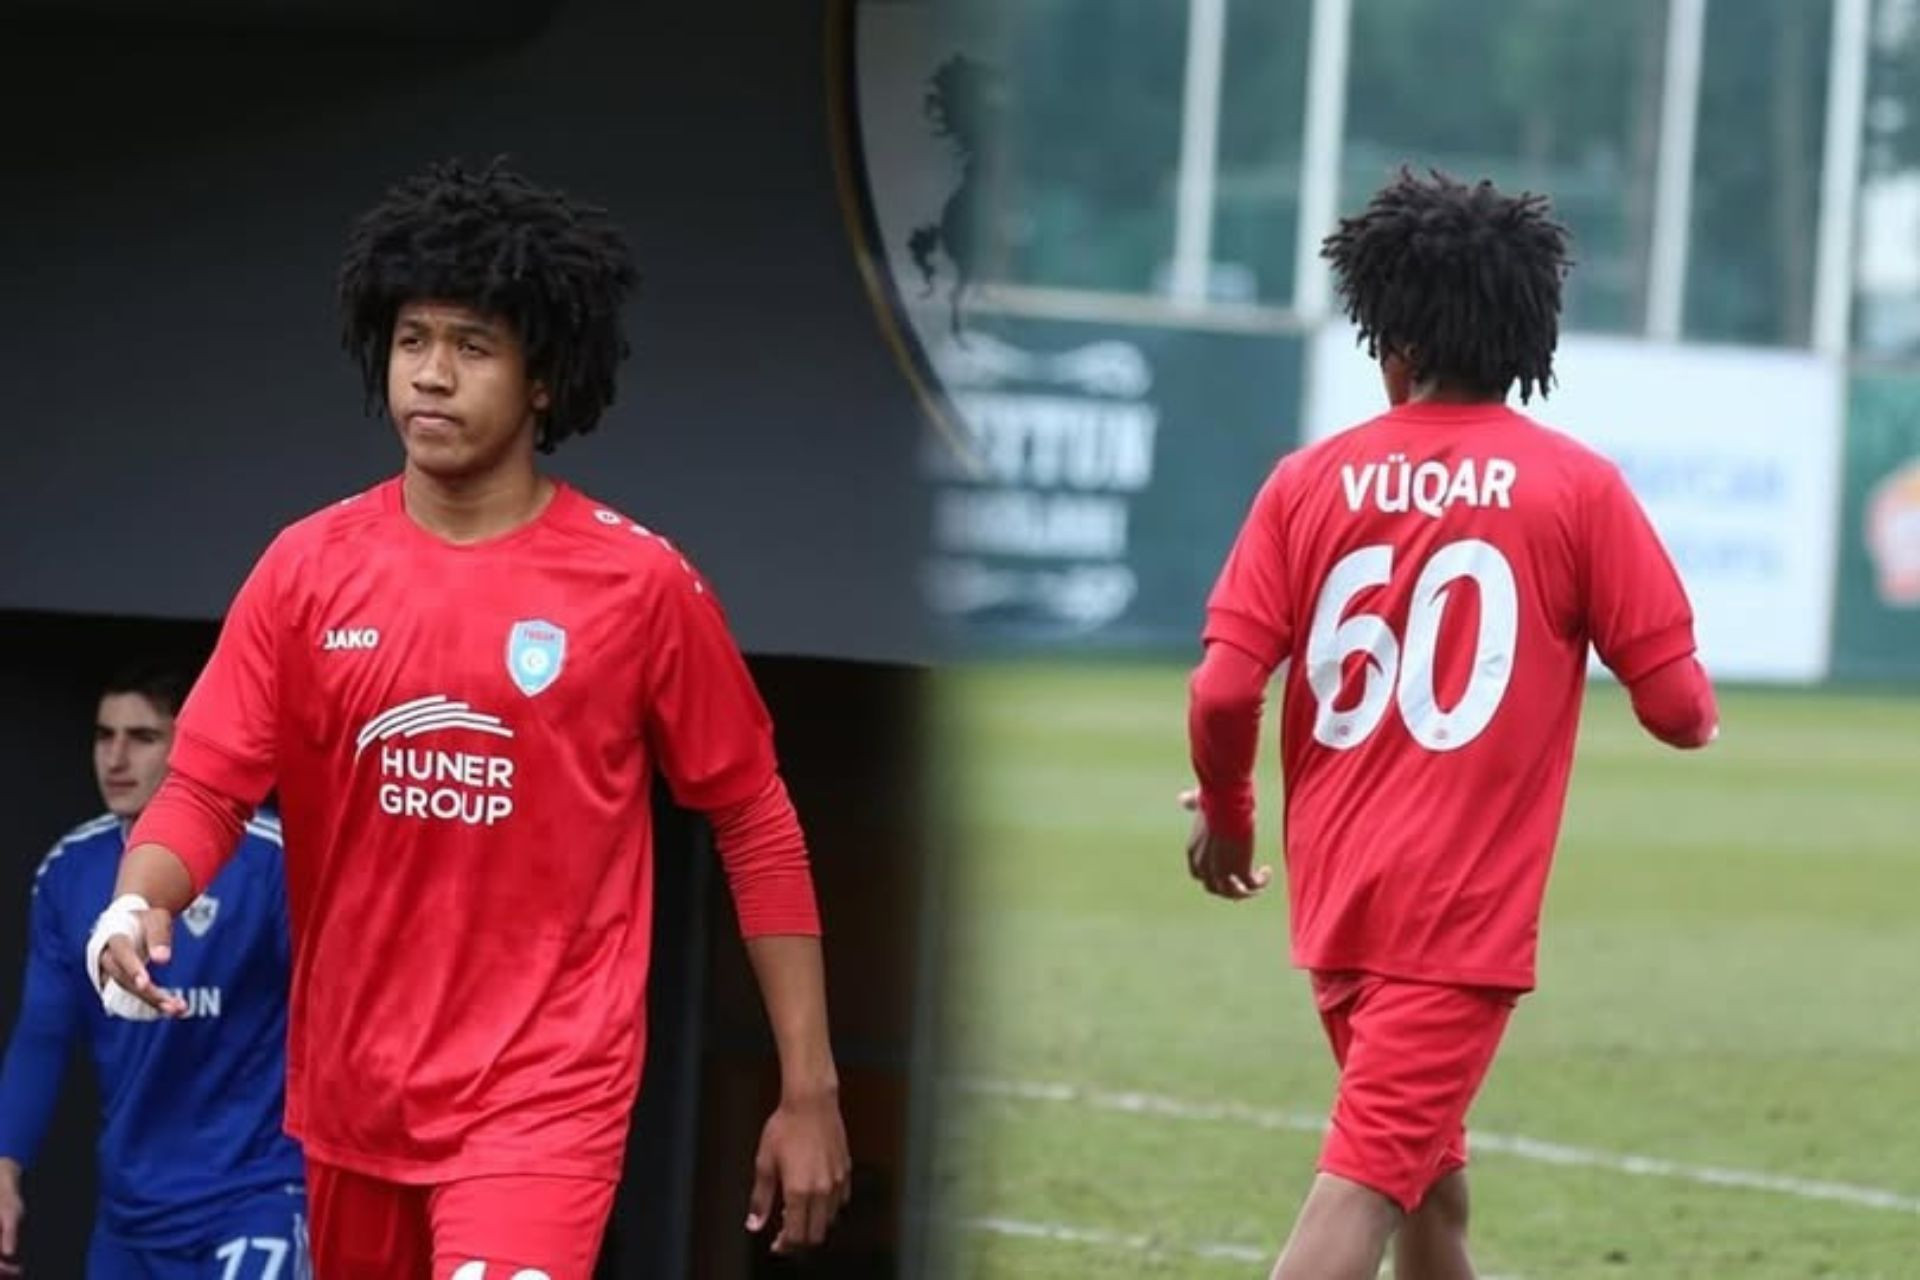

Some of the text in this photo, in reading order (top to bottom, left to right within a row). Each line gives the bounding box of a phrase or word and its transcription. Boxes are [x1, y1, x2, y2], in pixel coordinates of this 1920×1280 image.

[1341, 453, 1517, 518] VÜQAR
[324, 628, 379, 651] JAKO
[1306, 539, 1518, 751] 60
[380, 746, 514, 788] HUNER
[379, 783, 514, 825] GROUP
[168, 986, 221, 1018] UN
[216, 1236, 288, 1280] 17
